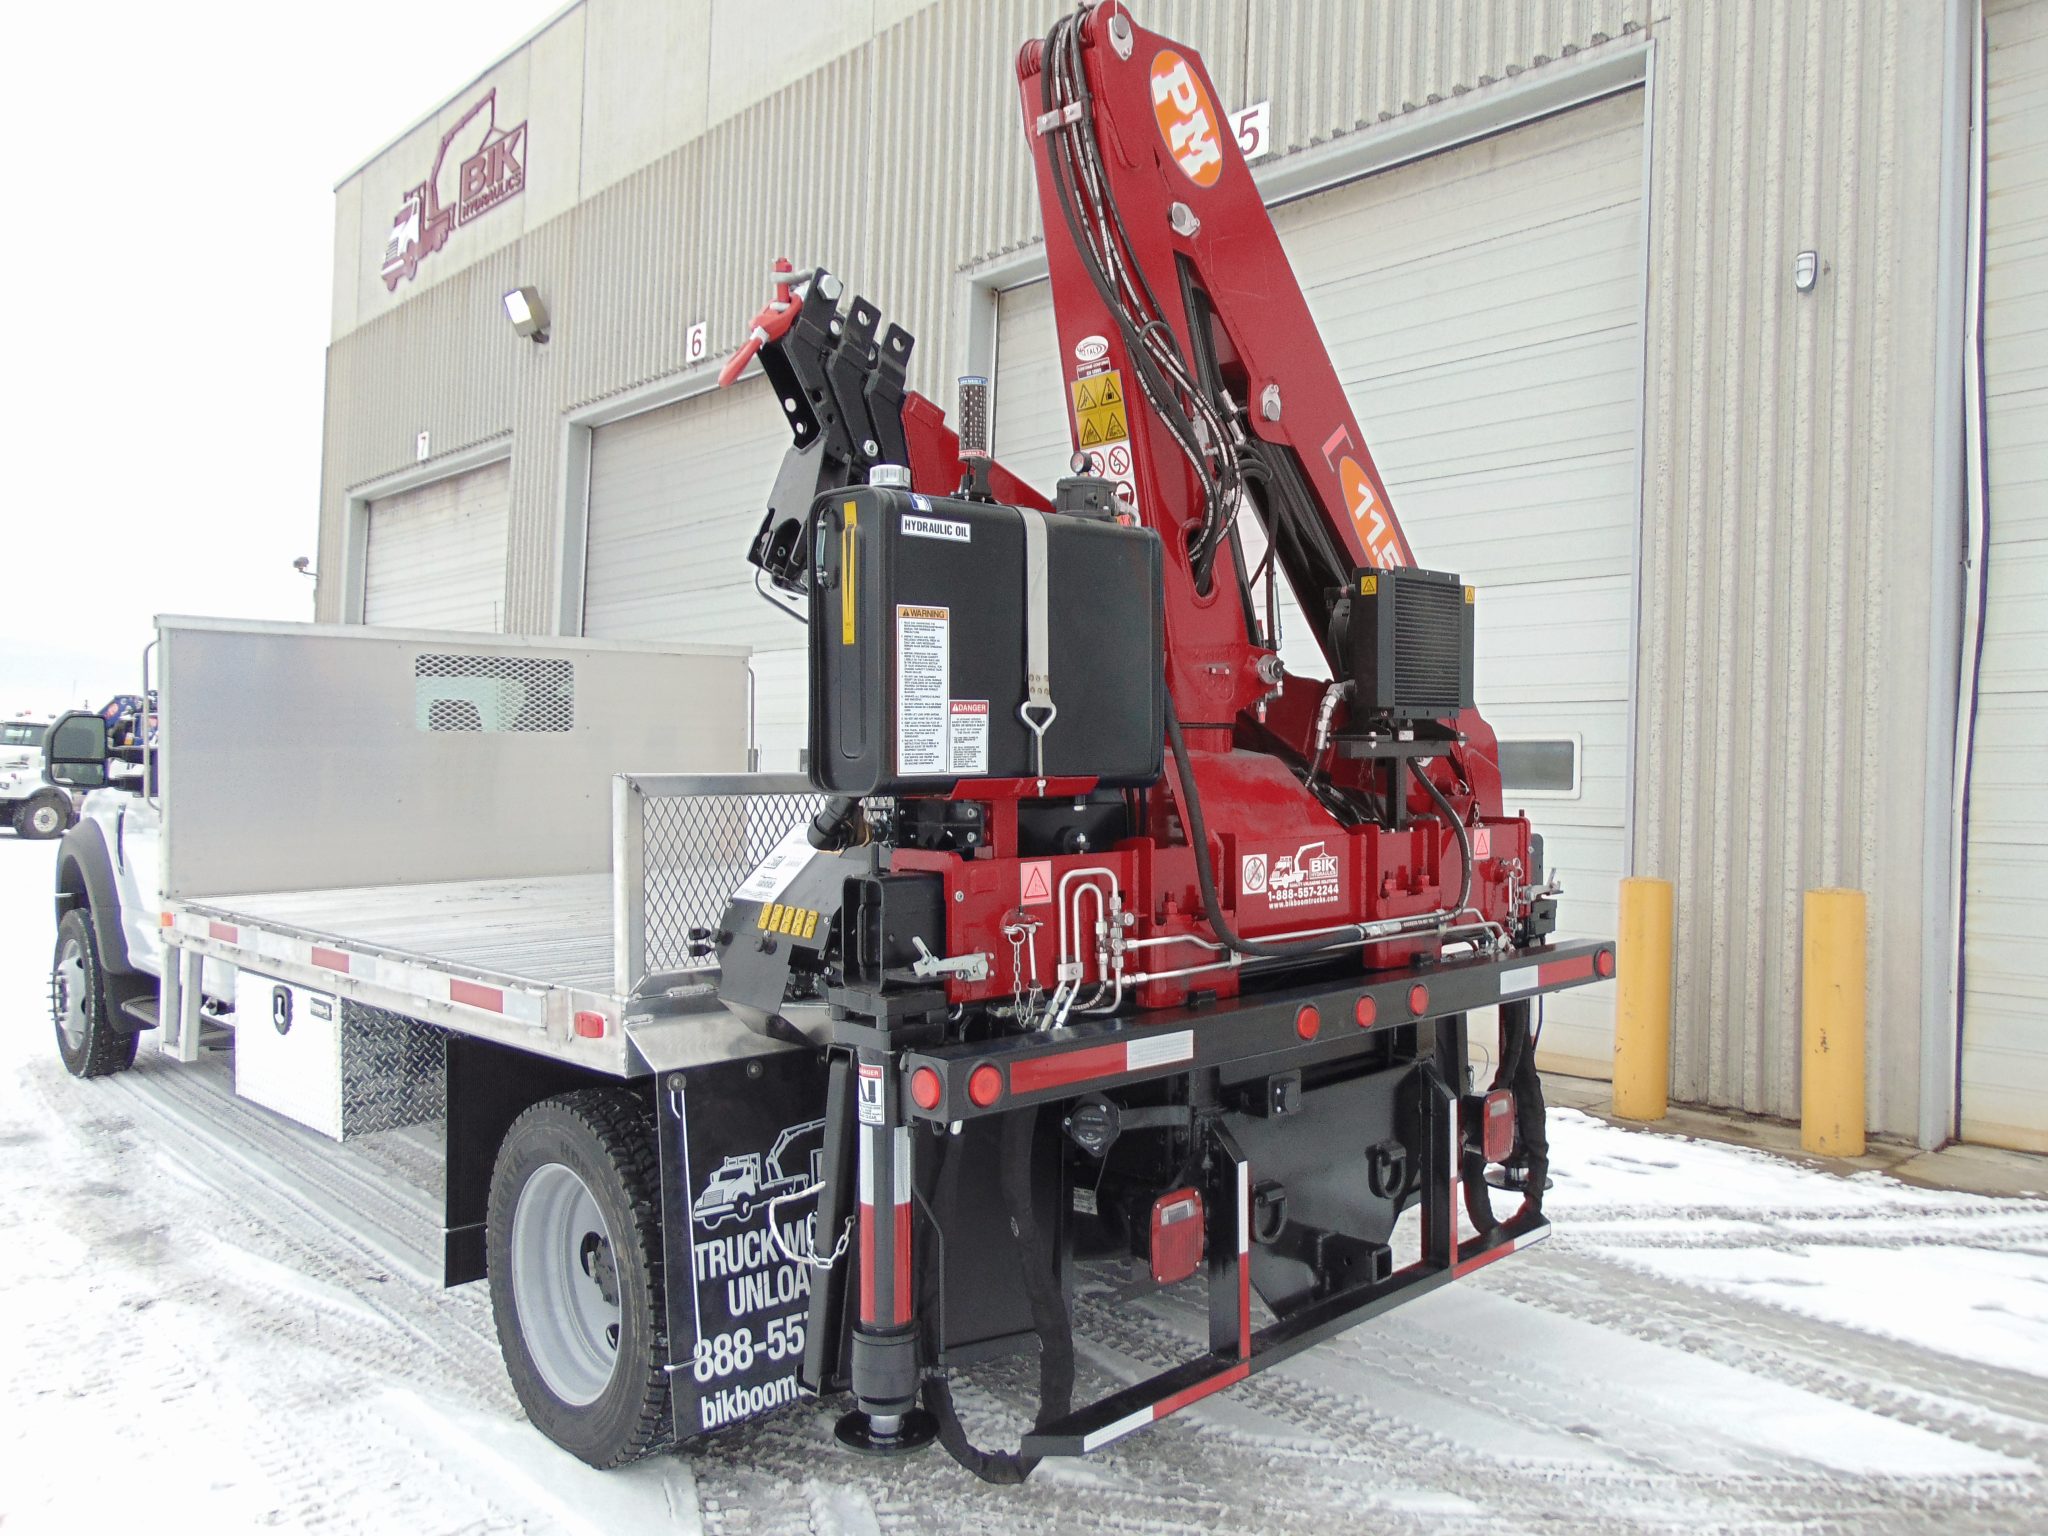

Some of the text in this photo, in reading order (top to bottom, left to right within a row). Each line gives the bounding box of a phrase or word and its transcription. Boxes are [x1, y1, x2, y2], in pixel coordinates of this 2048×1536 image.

[1151, 60, 1221, 178] PM
[1238, 109, 1260, 157] 5
[462, 130, 522, 202] BIK
[692, 329, 702, 357] 6
[904, 519, 969, 538] HYDRAULIC OIL
[910, 608, 945, 619] WARNING
[958, 703, 986, 713] DANGER
[1311, 858, 1336, 873] BIK
[1268, 884, 1339, 901] 1-888-557-2244
[1269, 896, 1338, 909] www.bikboomtrucks.com
[695, 1228, 779, 1281] TRUCK
[693, 1311, 809, 1382] 888-55
